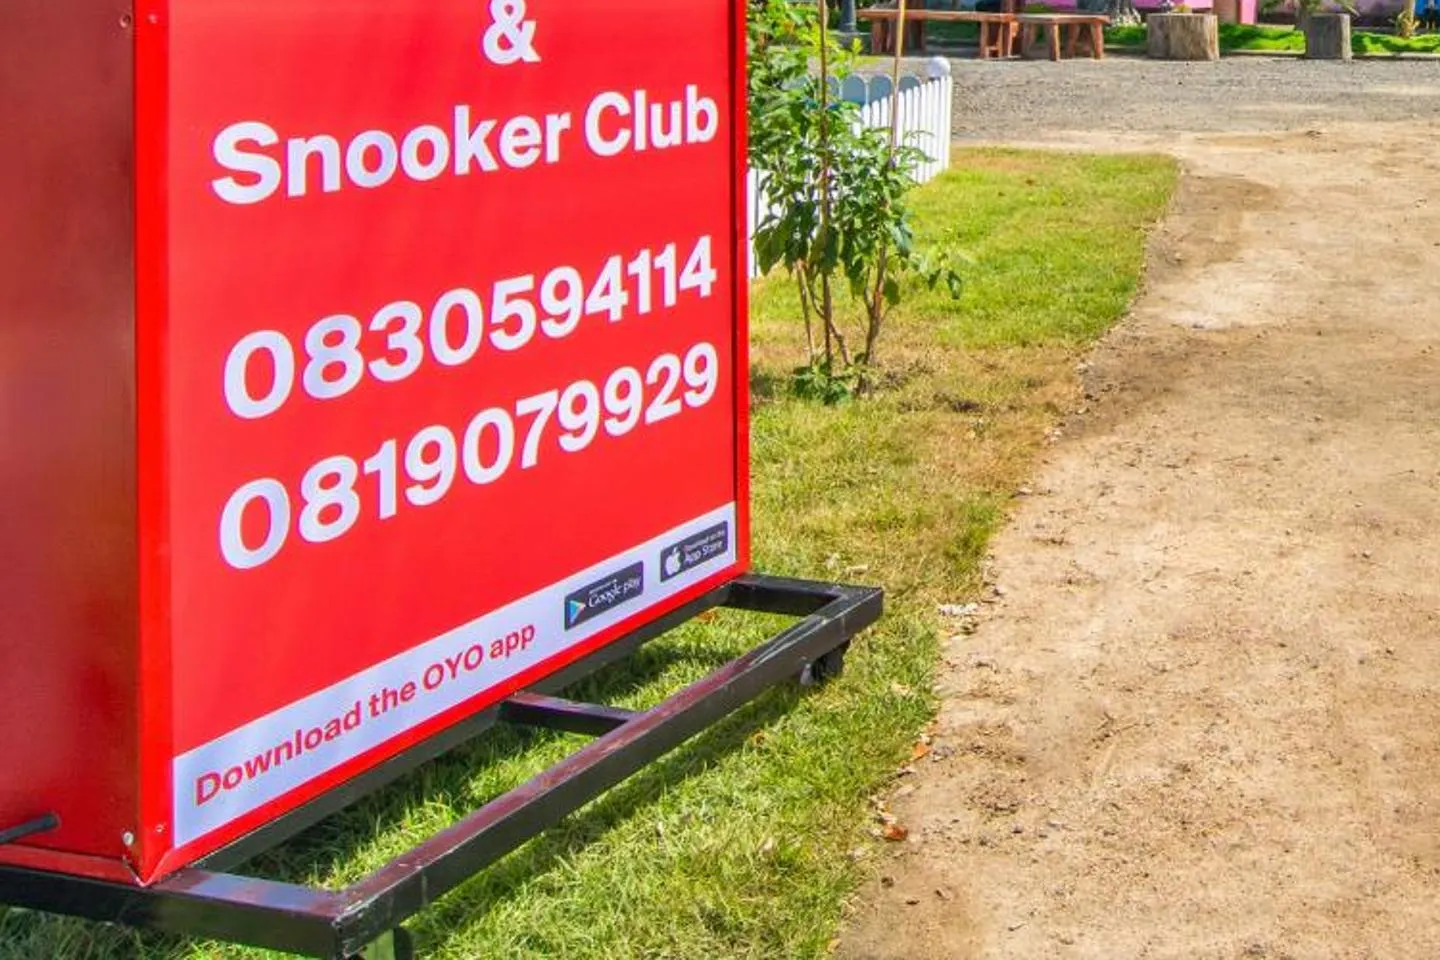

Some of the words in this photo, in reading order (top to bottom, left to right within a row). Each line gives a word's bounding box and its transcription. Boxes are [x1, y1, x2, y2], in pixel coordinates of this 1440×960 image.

[212, 105, 571, 205] Snooker
[585, 84, 719, 156] Club
[224, 235, 717, 419] 0830594114
[220, 342, 718, 569] 0819079929
[194, 700, 361, 807] Download
[368, 681, 417, 718] the
[423, 644, 483, 691] OYO
[490, 623, 536, 661] app
